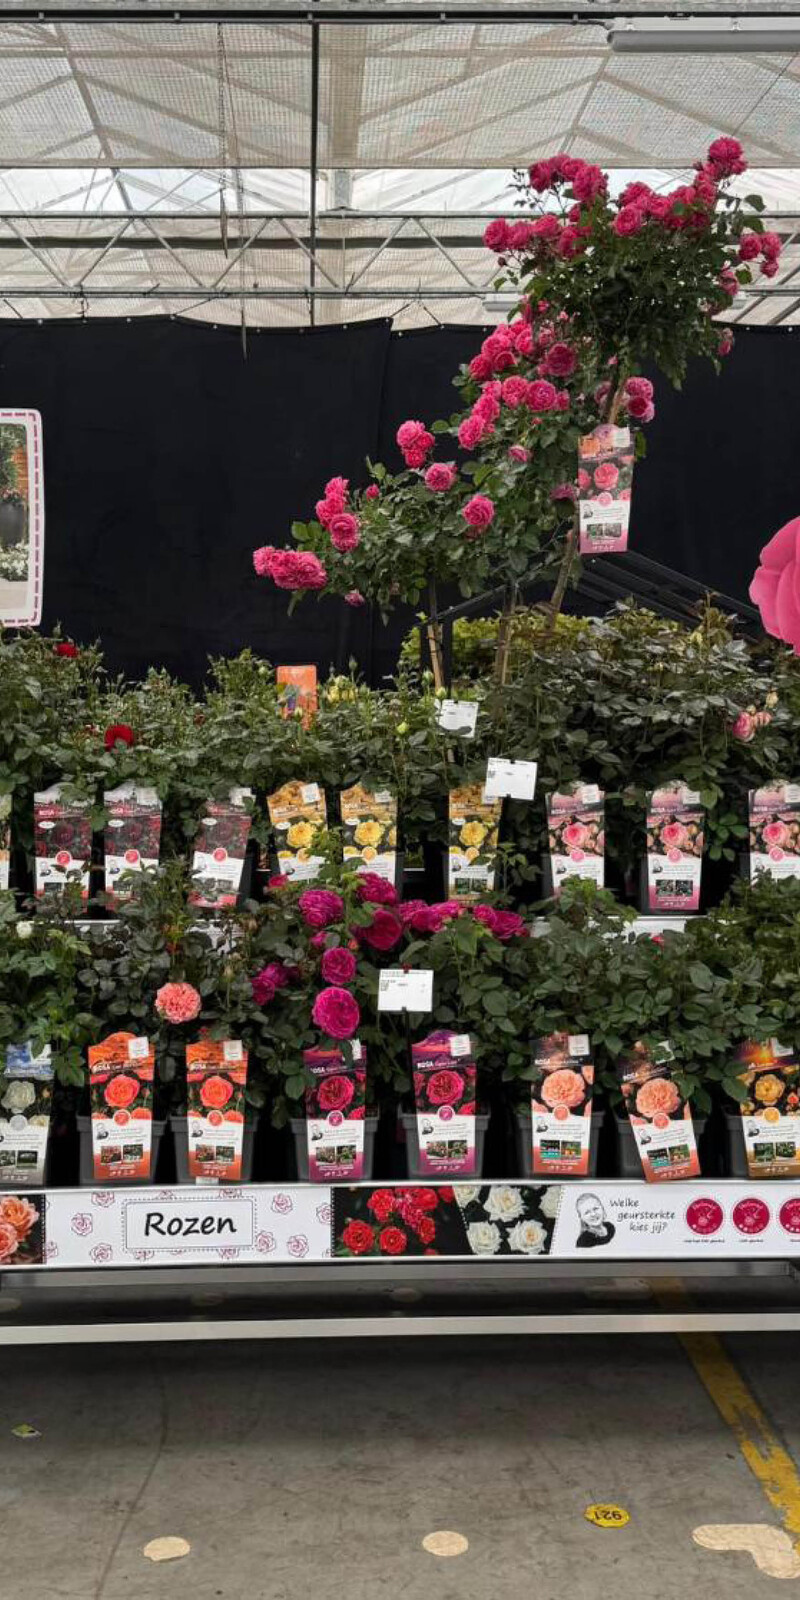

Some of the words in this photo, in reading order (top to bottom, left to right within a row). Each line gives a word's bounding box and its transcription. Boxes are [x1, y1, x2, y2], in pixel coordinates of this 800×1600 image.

[609, 1197, 640, 1208] Welke
[616, 1210, 675, 1222] geursterkte
[144, 1212, 237, 1237] Rozen
[629, 1221, 649, 1232] kies
[650, 1221, 668, 1234] jij?
[594, 1510, 622, 1520] 921
